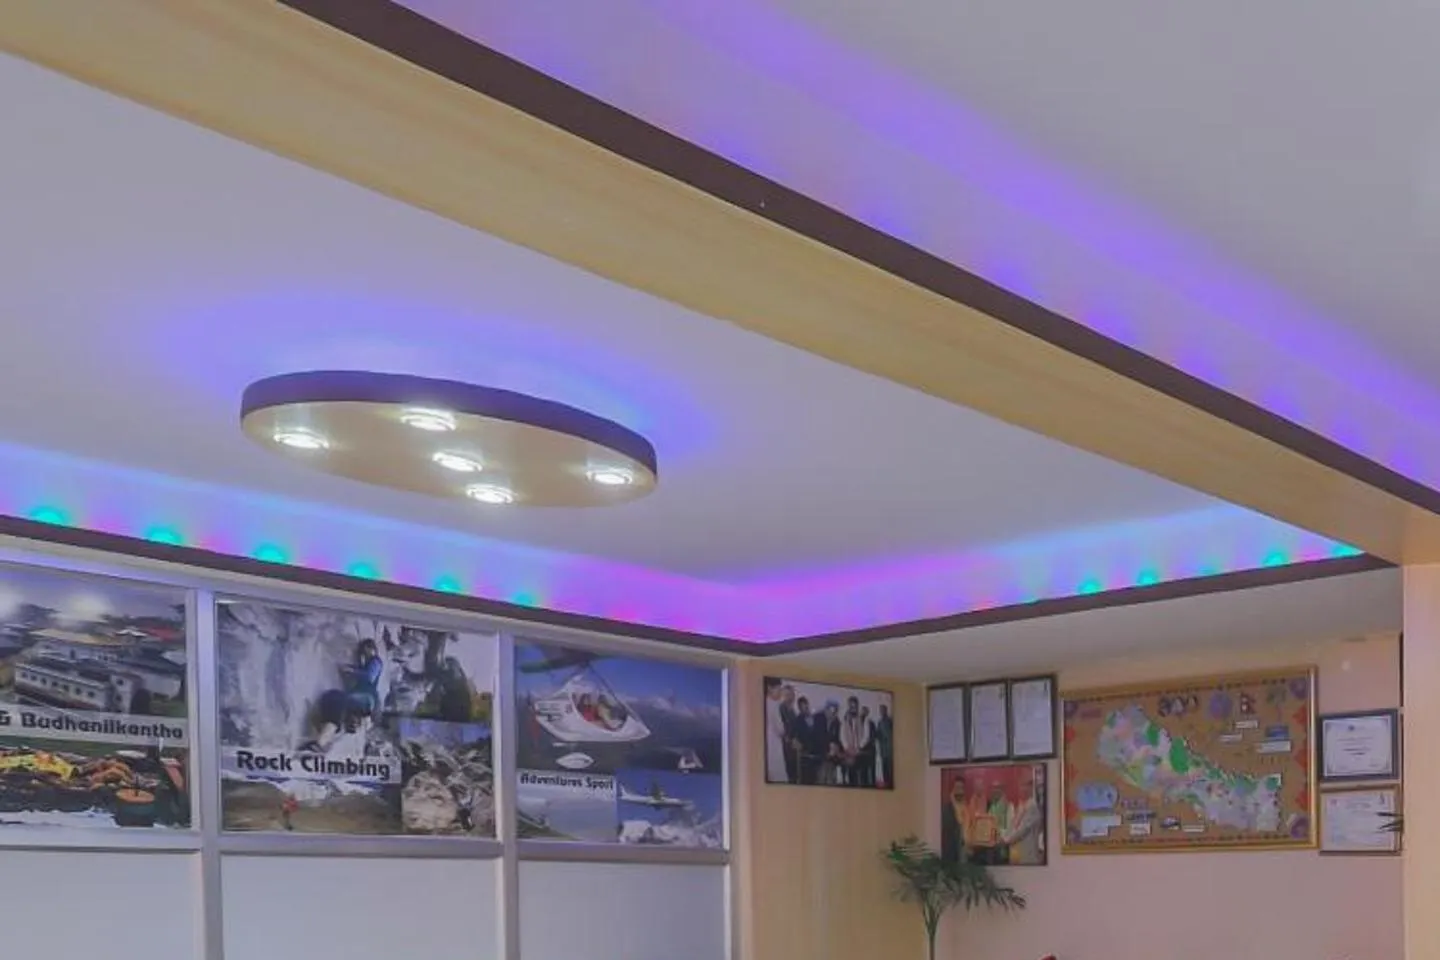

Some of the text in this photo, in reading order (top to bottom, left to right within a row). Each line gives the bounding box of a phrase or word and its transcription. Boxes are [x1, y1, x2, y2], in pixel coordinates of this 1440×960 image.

[20, 711, 184, 739] Budhanilkantha
[236, 750, 390, 781] Rock Climbing
